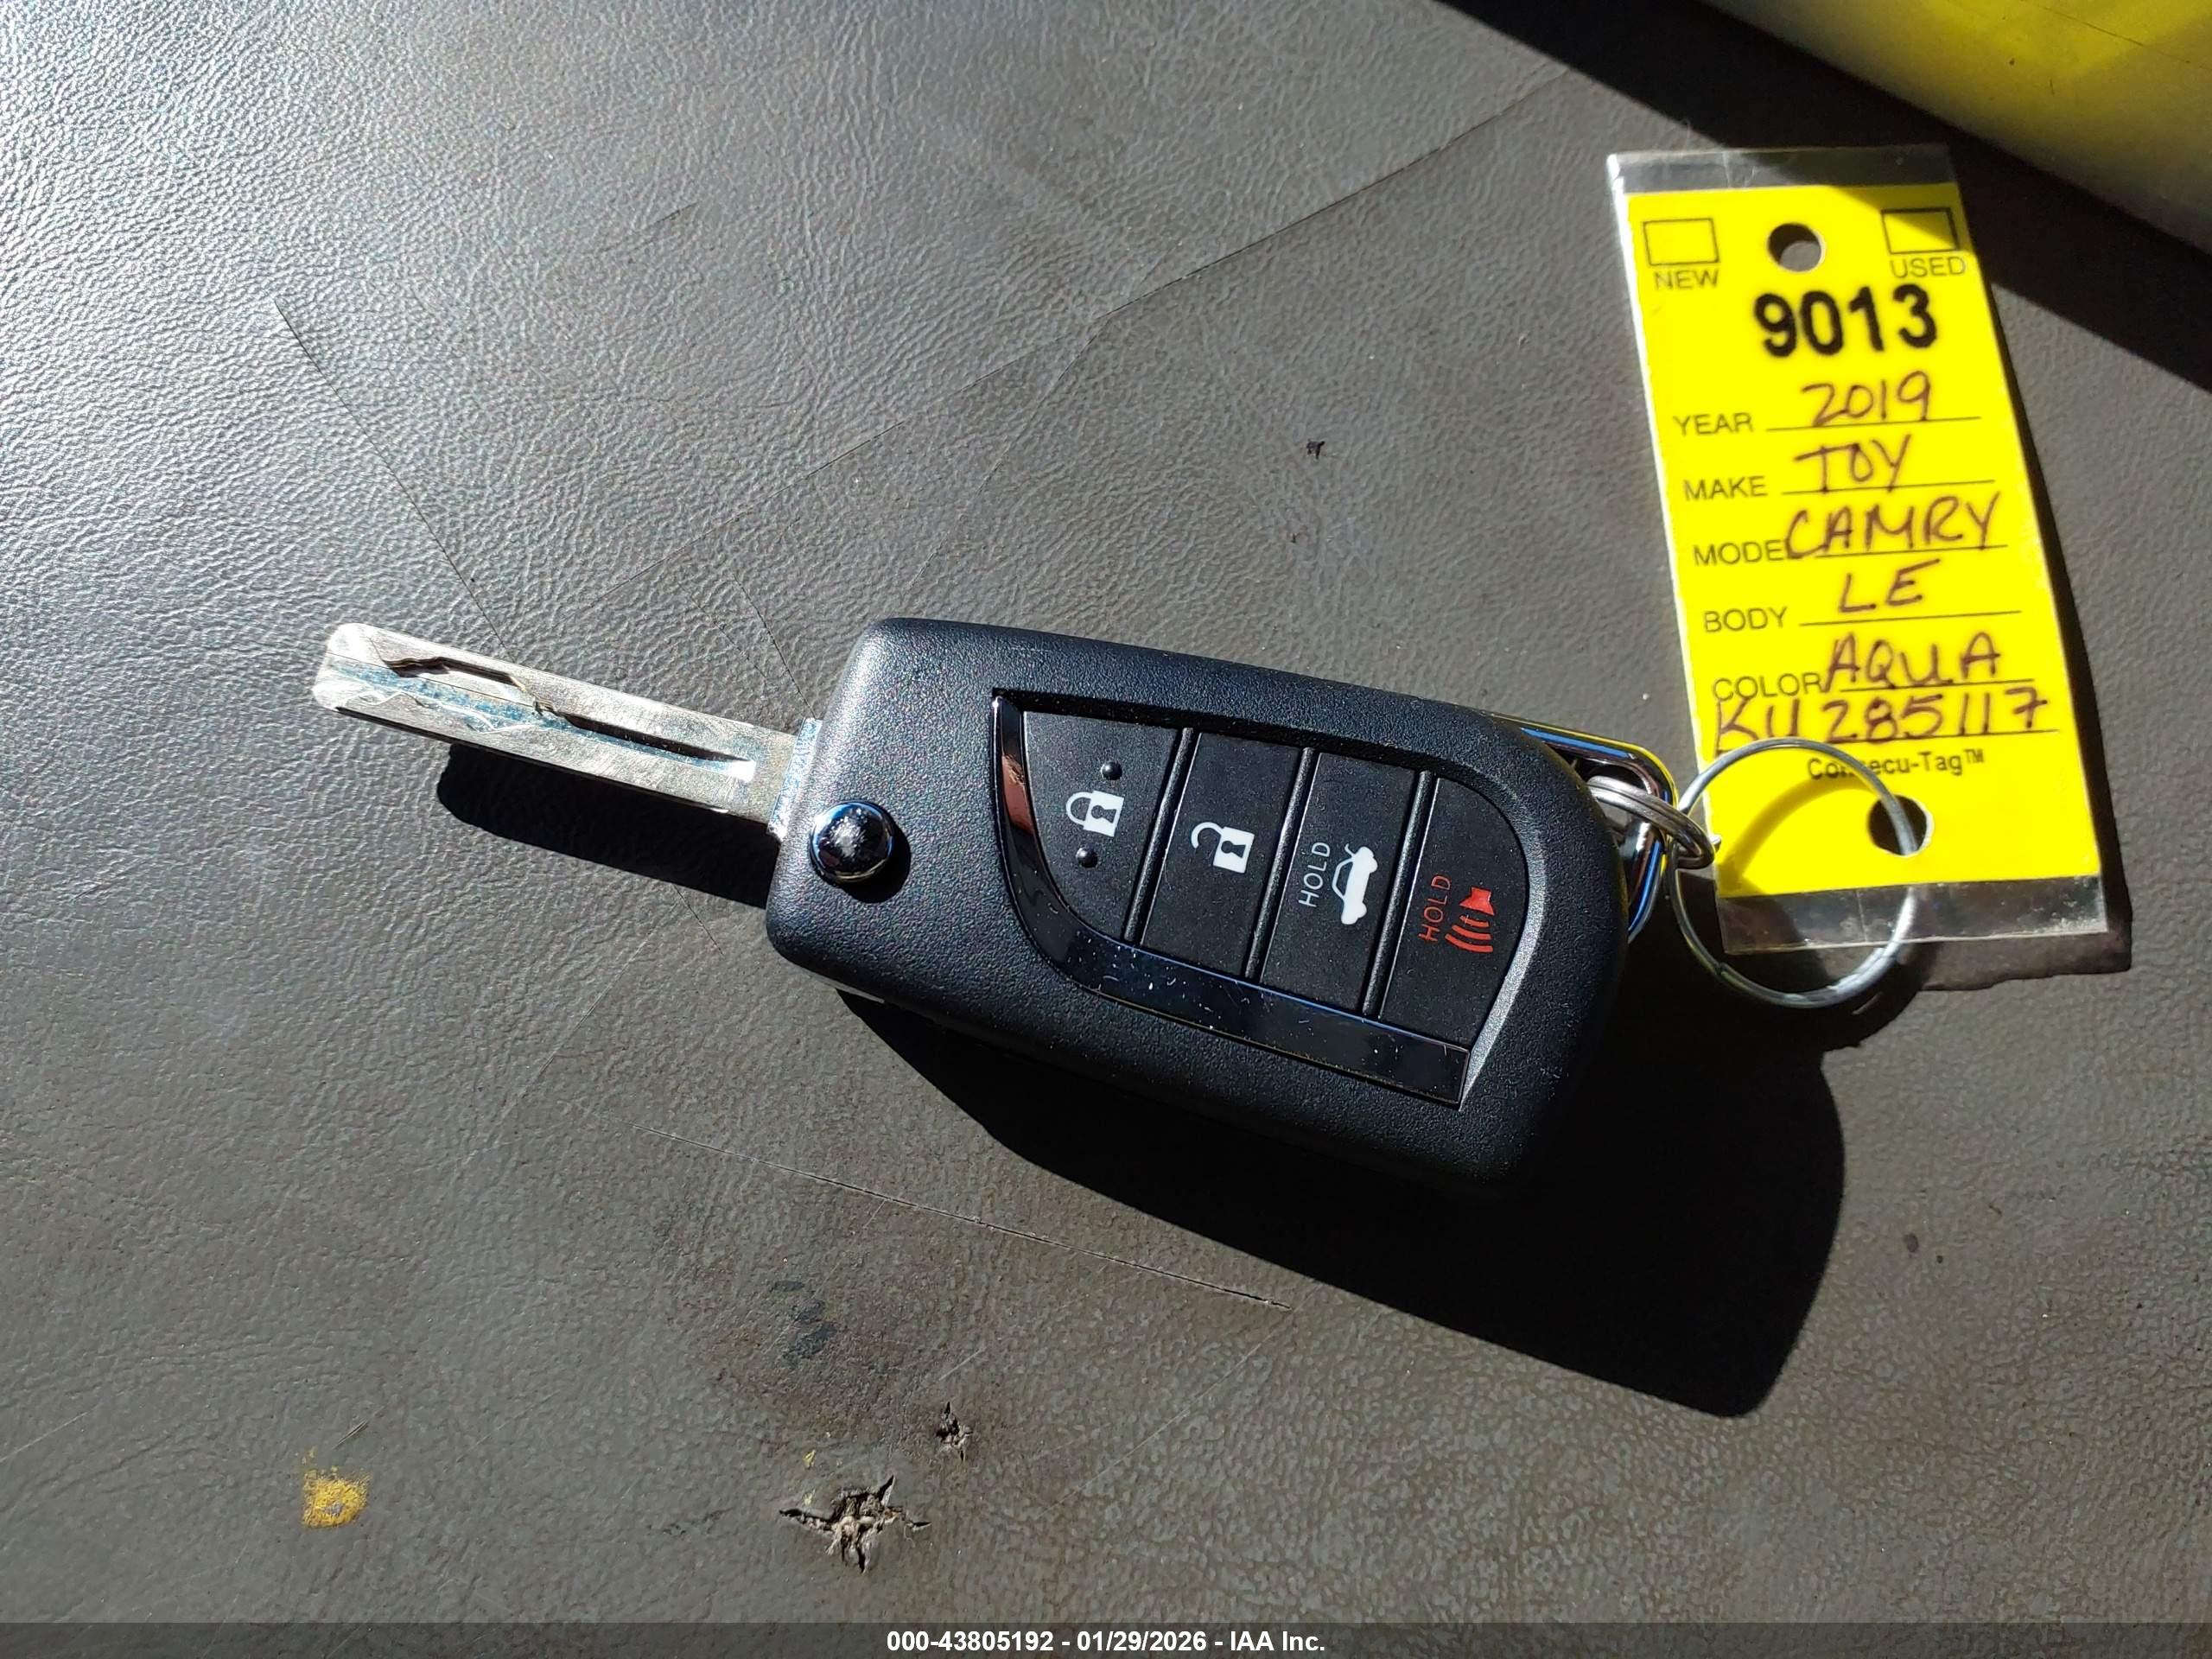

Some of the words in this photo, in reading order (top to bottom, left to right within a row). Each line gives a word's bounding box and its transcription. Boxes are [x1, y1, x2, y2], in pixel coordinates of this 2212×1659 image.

[1654, 270, 1719, 289] NEW
[1890, 257, 1966, 277] USED
[1753, 283, 1937, 358] 9013
[1674, 413, 1754, 437] YEAR
[1801, 372, 1931, 429] 2019
[1684, 476, 1768, 501] MAKE
[1793, 435, 1911, 493] TOY
[1784, 492, 2000, 558] CAMRY
[1839, 559, 1940, 613] LE
[1704, 607, 1787, 632] BODY
[1713, 673, 1822, 702] COLOR
[1821, 632, 2001, 693] AQUA
[1807, 748, 1985, 780] Coecu-Tag™
[1298, 841, 1332, 907] HOLD
[1417, 874, 1452, 942] HOLD
